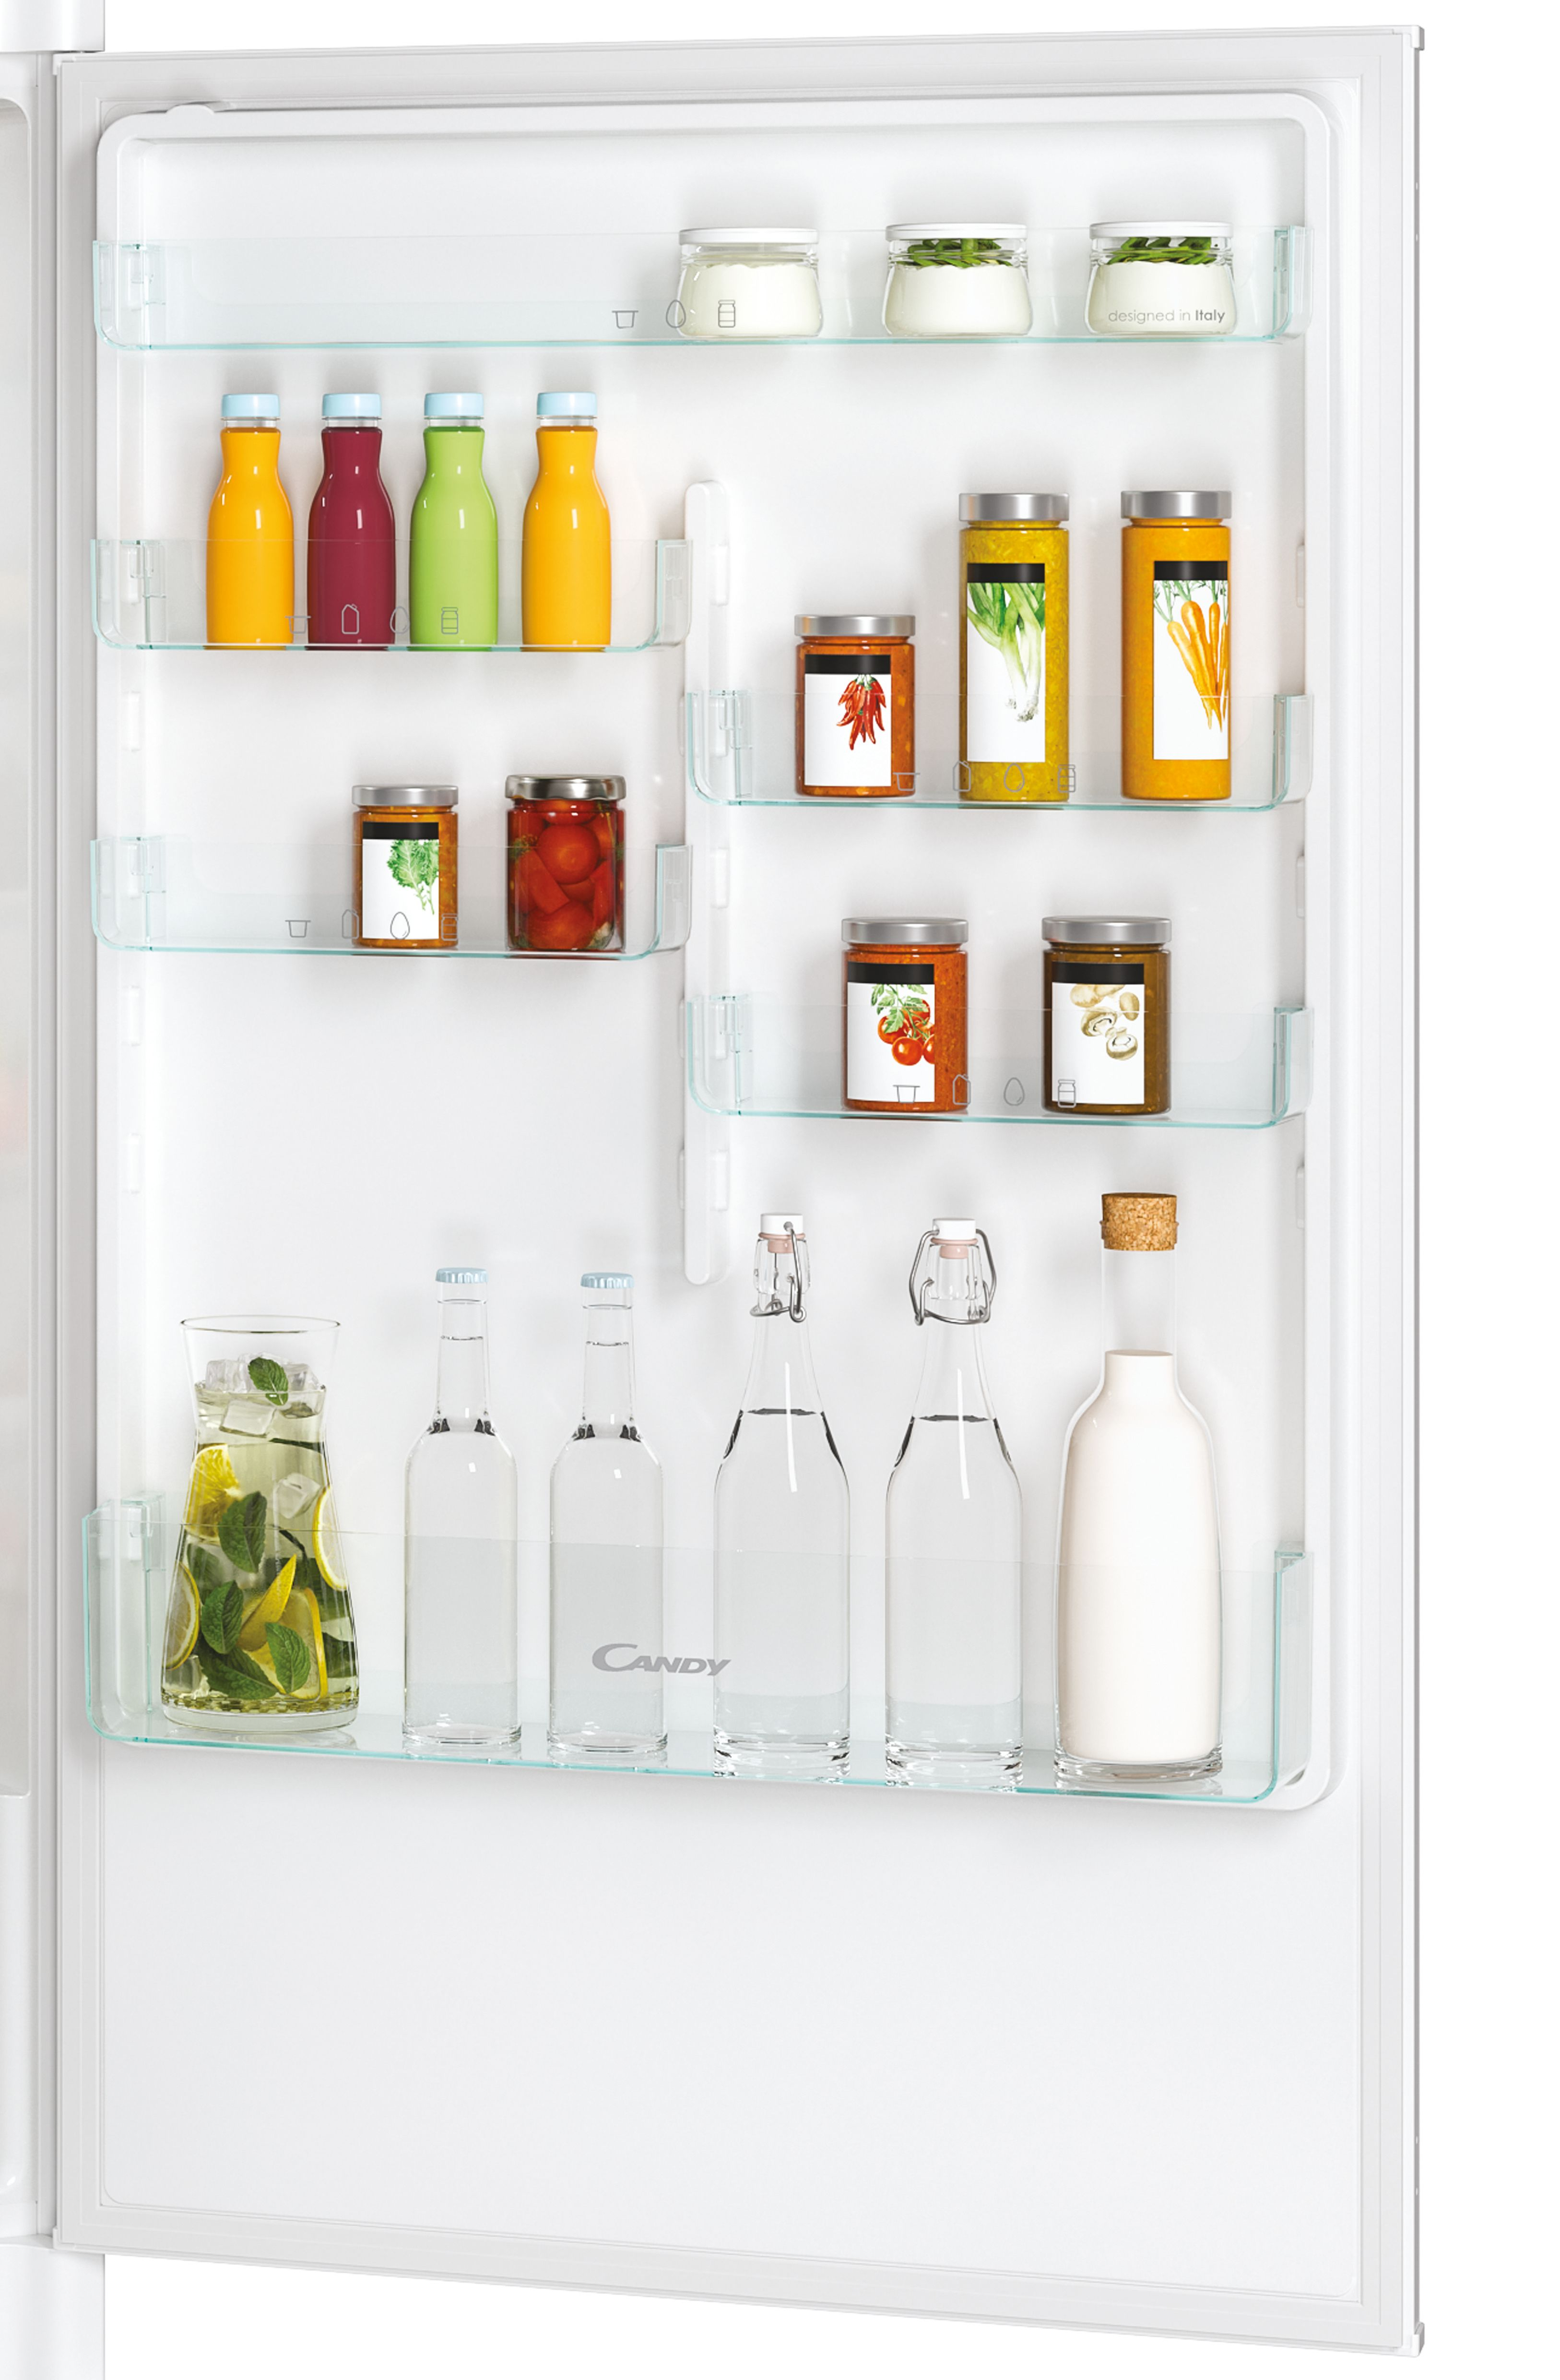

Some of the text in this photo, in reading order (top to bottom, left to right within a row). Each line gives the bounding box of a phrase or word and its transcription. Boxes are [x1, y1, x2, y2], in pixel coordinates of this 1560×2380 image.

[1108, 309, 1225, 324] designed in Italy
[592, 1643, 732, 1676] CANDY
